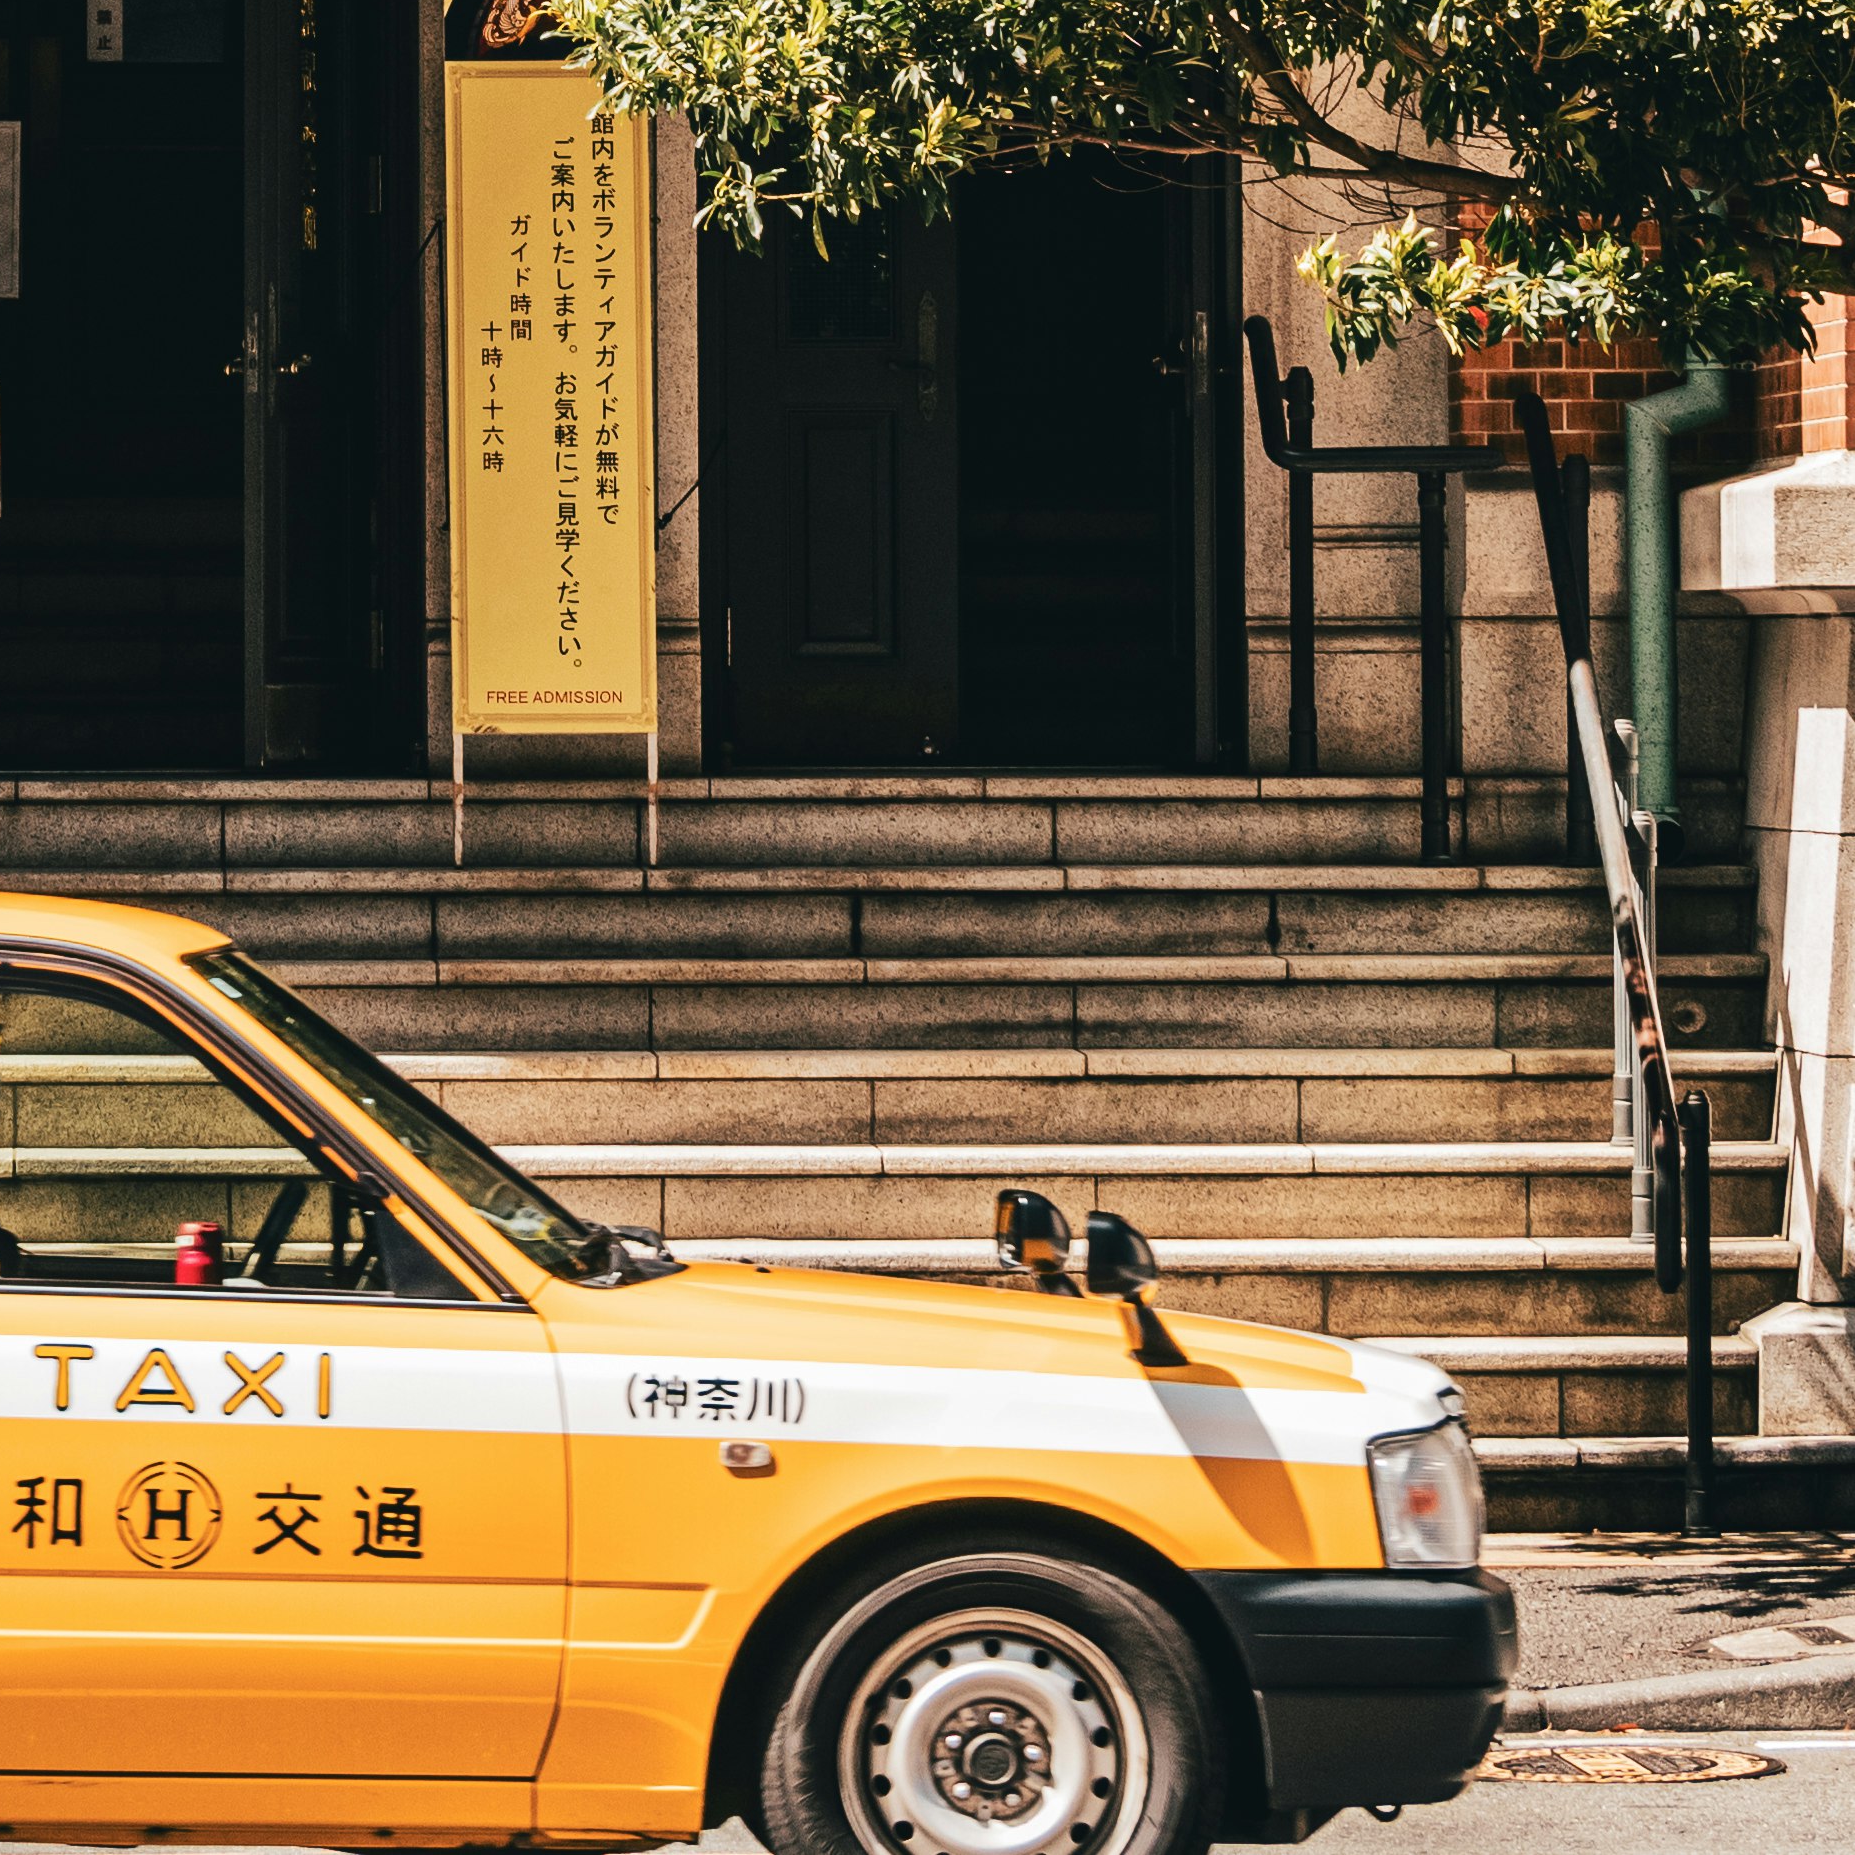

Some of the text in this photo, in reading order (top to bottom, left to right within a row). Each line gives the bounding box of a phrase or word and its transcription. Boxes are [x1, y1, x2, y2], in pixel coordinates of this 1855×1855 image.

[510, 214, 533, 342] ガイド時間
[589, 112, 620, 525] 館内をボランティアガイドが無料で
[550, 136, 582, 668] ご案内いたします。お気軽にご見学ください。
[486, 690, 623, 704] FREE ADMISSION
[33, 1343, 332, 1420] TAXI
[626, 1372, 805, 1425] (神奈川)
[253, 1483, 424, 1560] 交通
